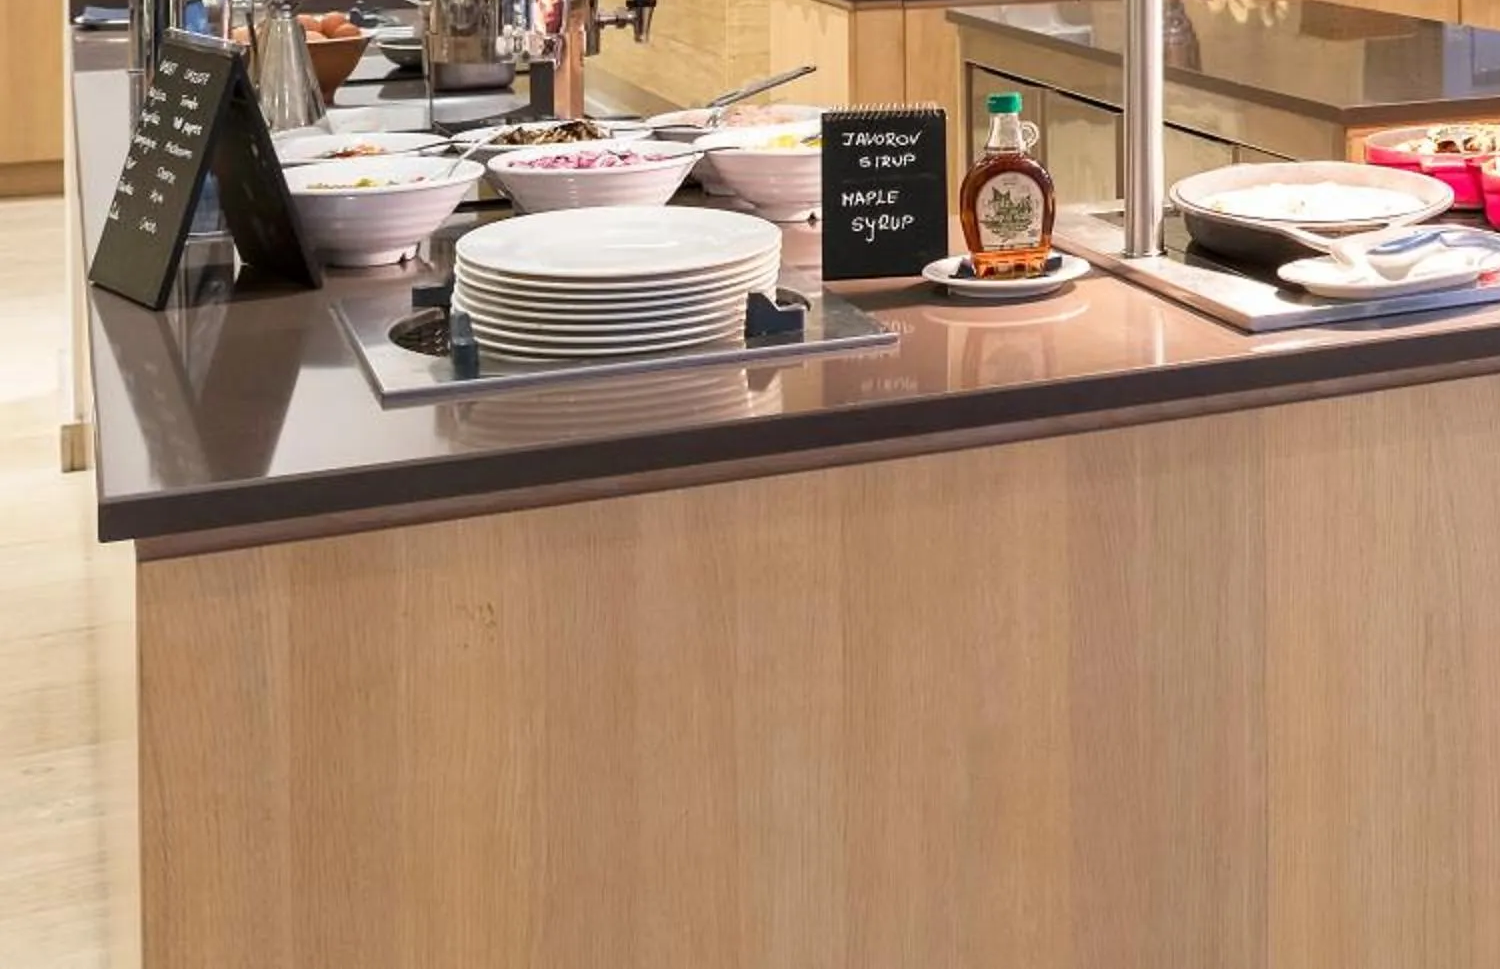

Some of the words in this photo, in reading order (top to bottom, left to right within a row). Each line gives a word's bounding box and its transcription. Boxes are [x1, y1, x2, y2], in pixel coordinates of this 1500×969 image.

[842, 131, 922, 147] JAVOROV
[859, 153, 916, 168] SIRUP
[842, 189, 899, 206] MAPLE
